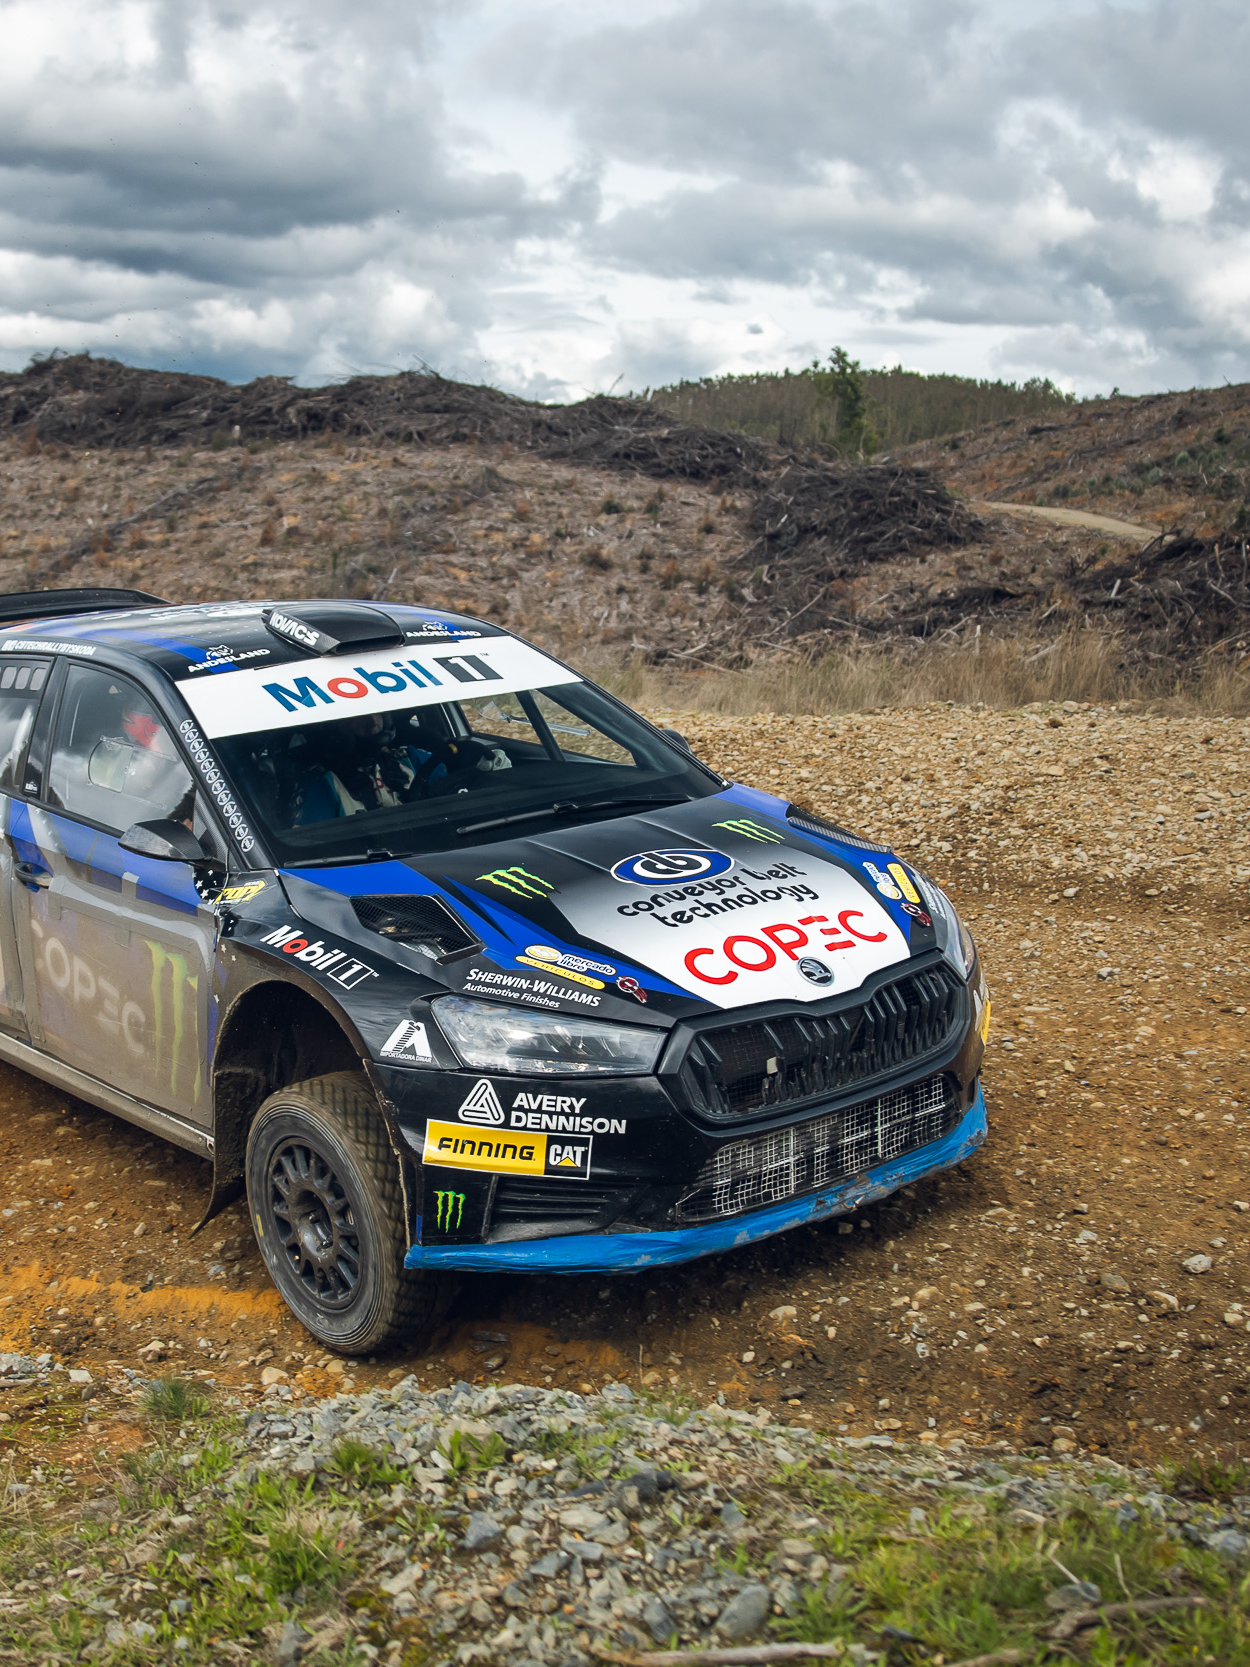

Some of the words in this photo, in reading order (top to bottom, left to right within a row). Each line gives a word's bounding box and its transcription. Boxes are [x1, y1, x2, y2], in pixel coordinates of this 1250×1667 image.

[269, 611, 320, 646] KOVACS
[188, 649, 271, 673] ANDESLAND
[262, 660, 444, 713] Mobil
[445, 655, 491, 682] 1
[617, 875, 747, 917] conveyor
[740, 862, 807, 881] belt
[650, 884, 820, 928] technology
[260, 925, 348, 971] Mobil
[336, 962, 365, 983] 1
[684, 910, 889, 986] COPEC
[526, 958, 595, 986] VEHICULOS
[559, 958, 585, 971] libre
[564, 955, 613, 974] mercado
[463, 982, 520, 999] Automotive
[521, 993, 560, 1009] Finishes
[466, 968, 601, 1007] SHERWIN-WILLIAMS
[512, 1092, 587, 1114] AVERY
[510, 1111, 627, 1134] DENNISON
[437, 1136, 535, 1162] FINNING
[549, 1144, 585, 1167] CAT
